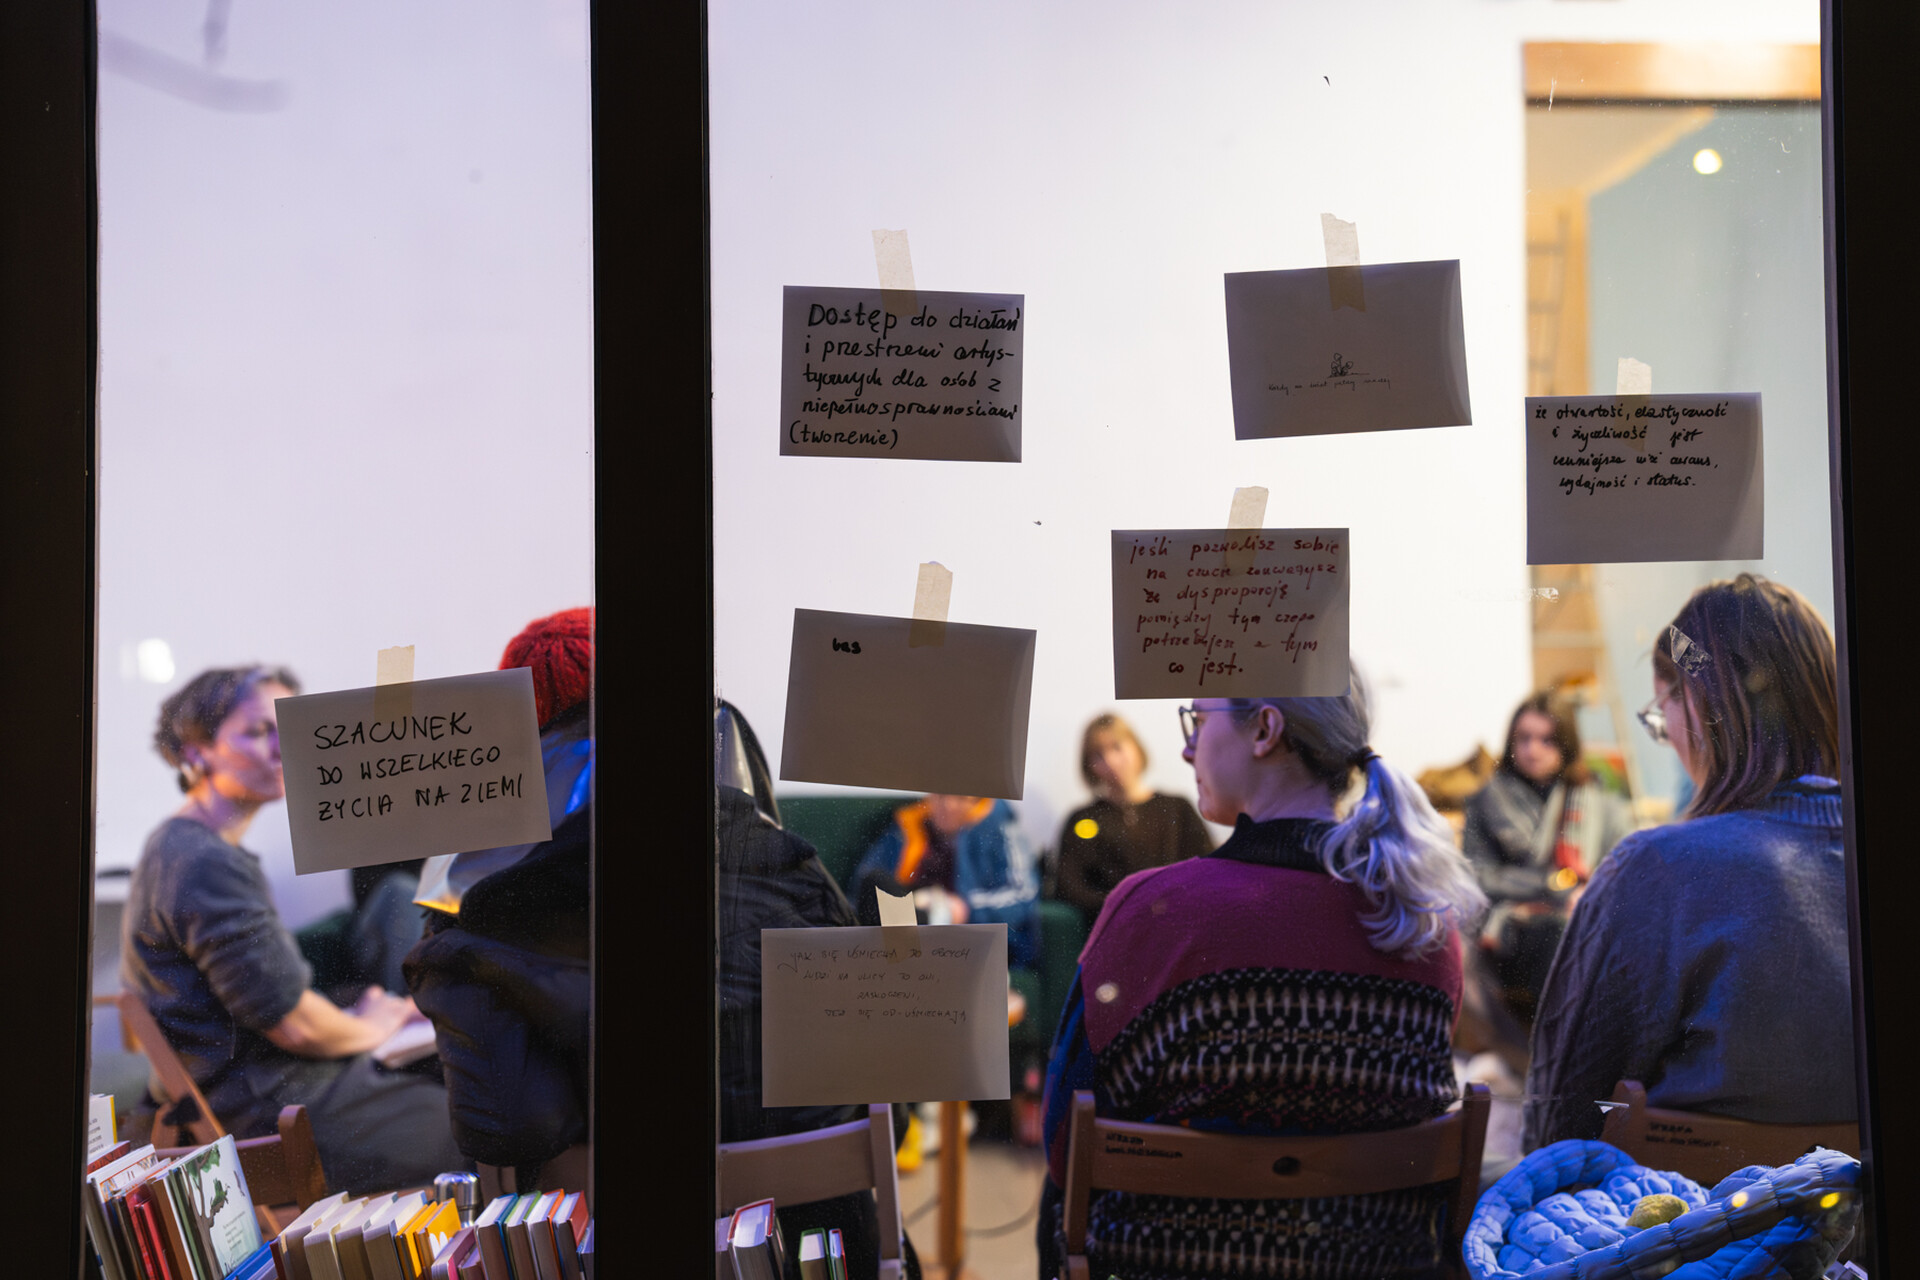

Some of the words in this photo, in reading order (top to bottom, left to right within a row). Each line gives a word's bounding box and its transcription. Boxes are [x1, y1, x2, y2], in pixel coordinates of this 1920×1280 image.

[808, 302, 897, 339] Dostęp
[911, 306, 937, 328] do
[950, 307, 1021, 331] działań
[805, 335, 811, 354] i
[892, 369, 929, 388] dla
[940, 371, 977, 388] osób
[987, 378, 1002, 393] z
[1535, 405, 1547, 419] że
[790, 420, 898, 450] (tworzenie)
[1552, 426, 1560, 438] i
[1670, 428, 1703, 448] jest
[1634, 477, 1640, 486] i
[1647, 472, 1697, 487] status.
[1130, 536, 1172, 564] jeśli
[1146, 568, 1167, 580] na
[1228, 607, 1261, 632] tym
[1280, 634, 1318, 664] tym
[1169, 662, 1185, 673] co
[1199, 652, 1243, 686] jest.
[314, 711, 473, 751] SZACUNEK
[317, 766, 344, 786] DO
[360, 746, 501, 780] WSZELKIEGO
[415, 785, 450, 807] NA
[461, 773, 523, 804] ZIEMI
[838, 972, 849, 981] NA
[898, 972, 911, 981] TO
